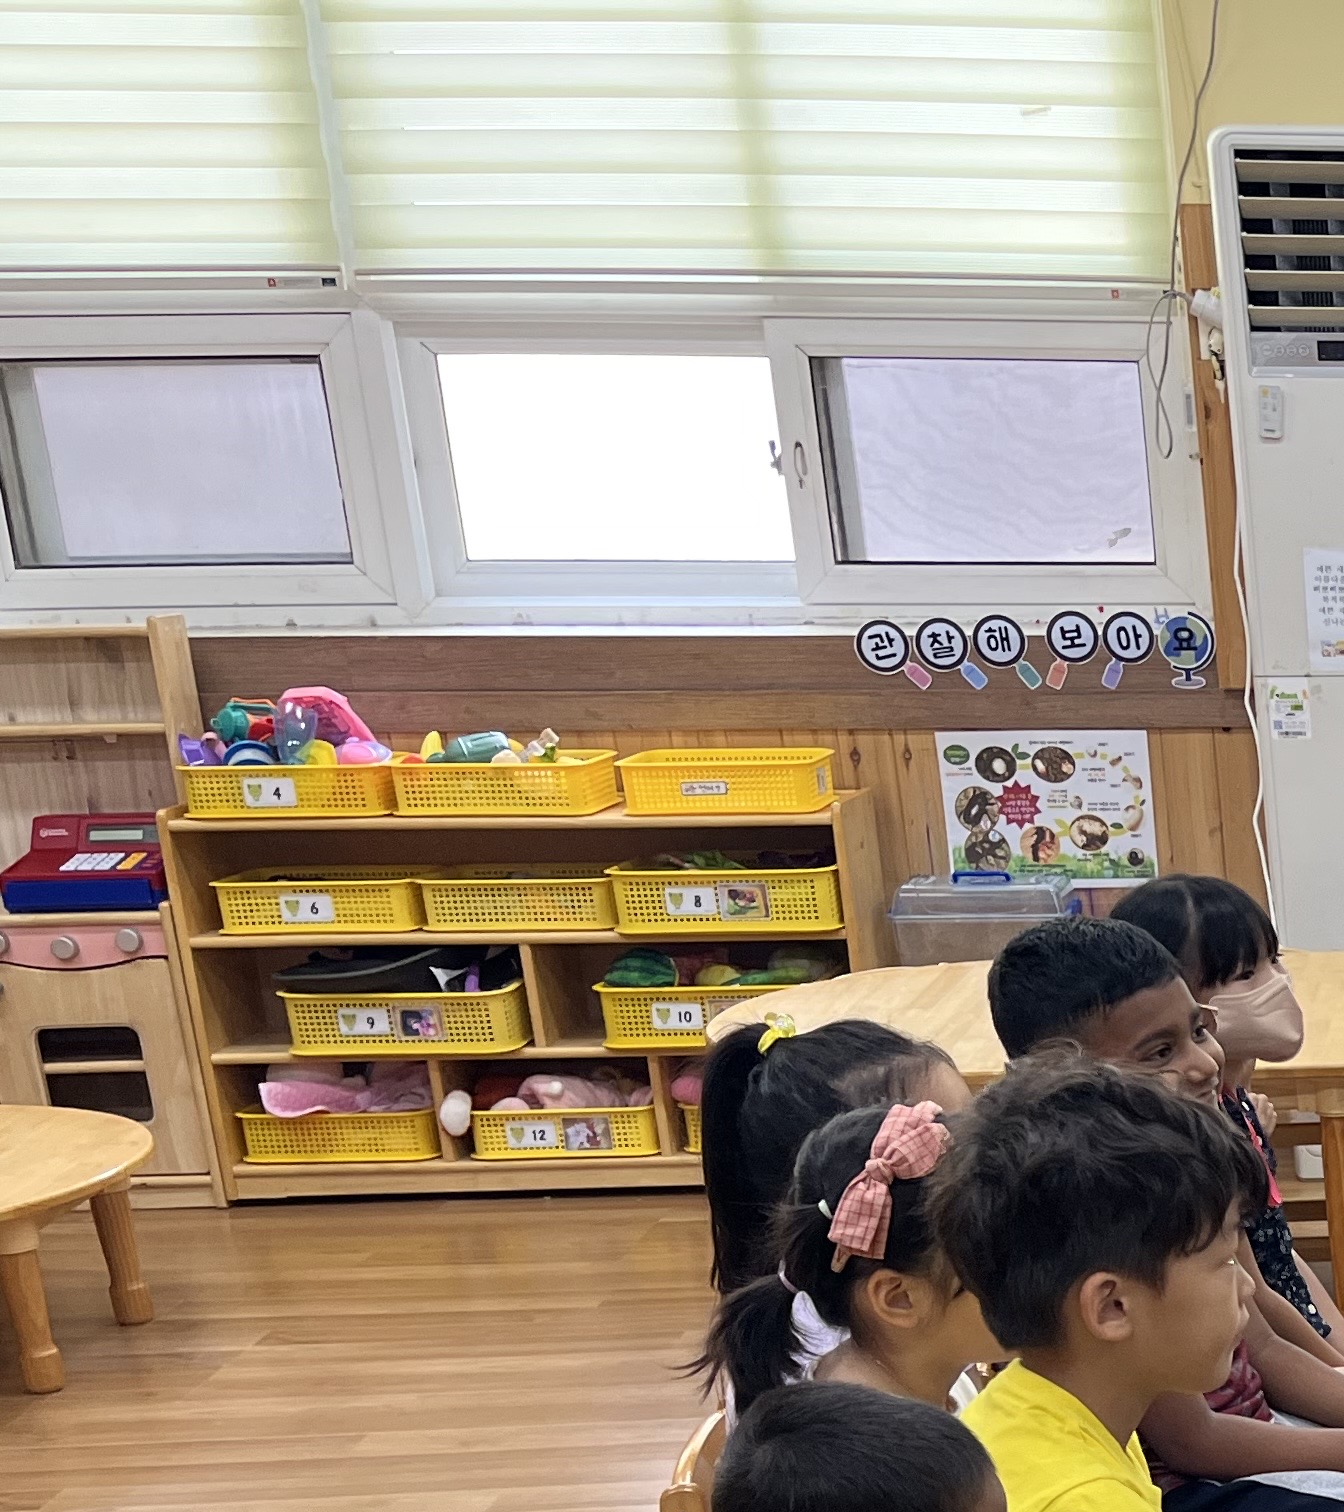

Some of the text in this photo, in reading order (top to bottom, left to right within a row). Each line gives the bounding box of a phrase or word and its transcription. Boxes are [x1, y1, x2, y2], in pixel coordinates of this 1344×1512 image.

[272, 787, 282, 800] 4
[310, 901, 319, 915] 6
[694, 895, 702, 908] 8
[366, 1016, 375, 1030] 9
[677, 1010, 692, 1023] 10
[532, 1129, 546, 1141] 12
